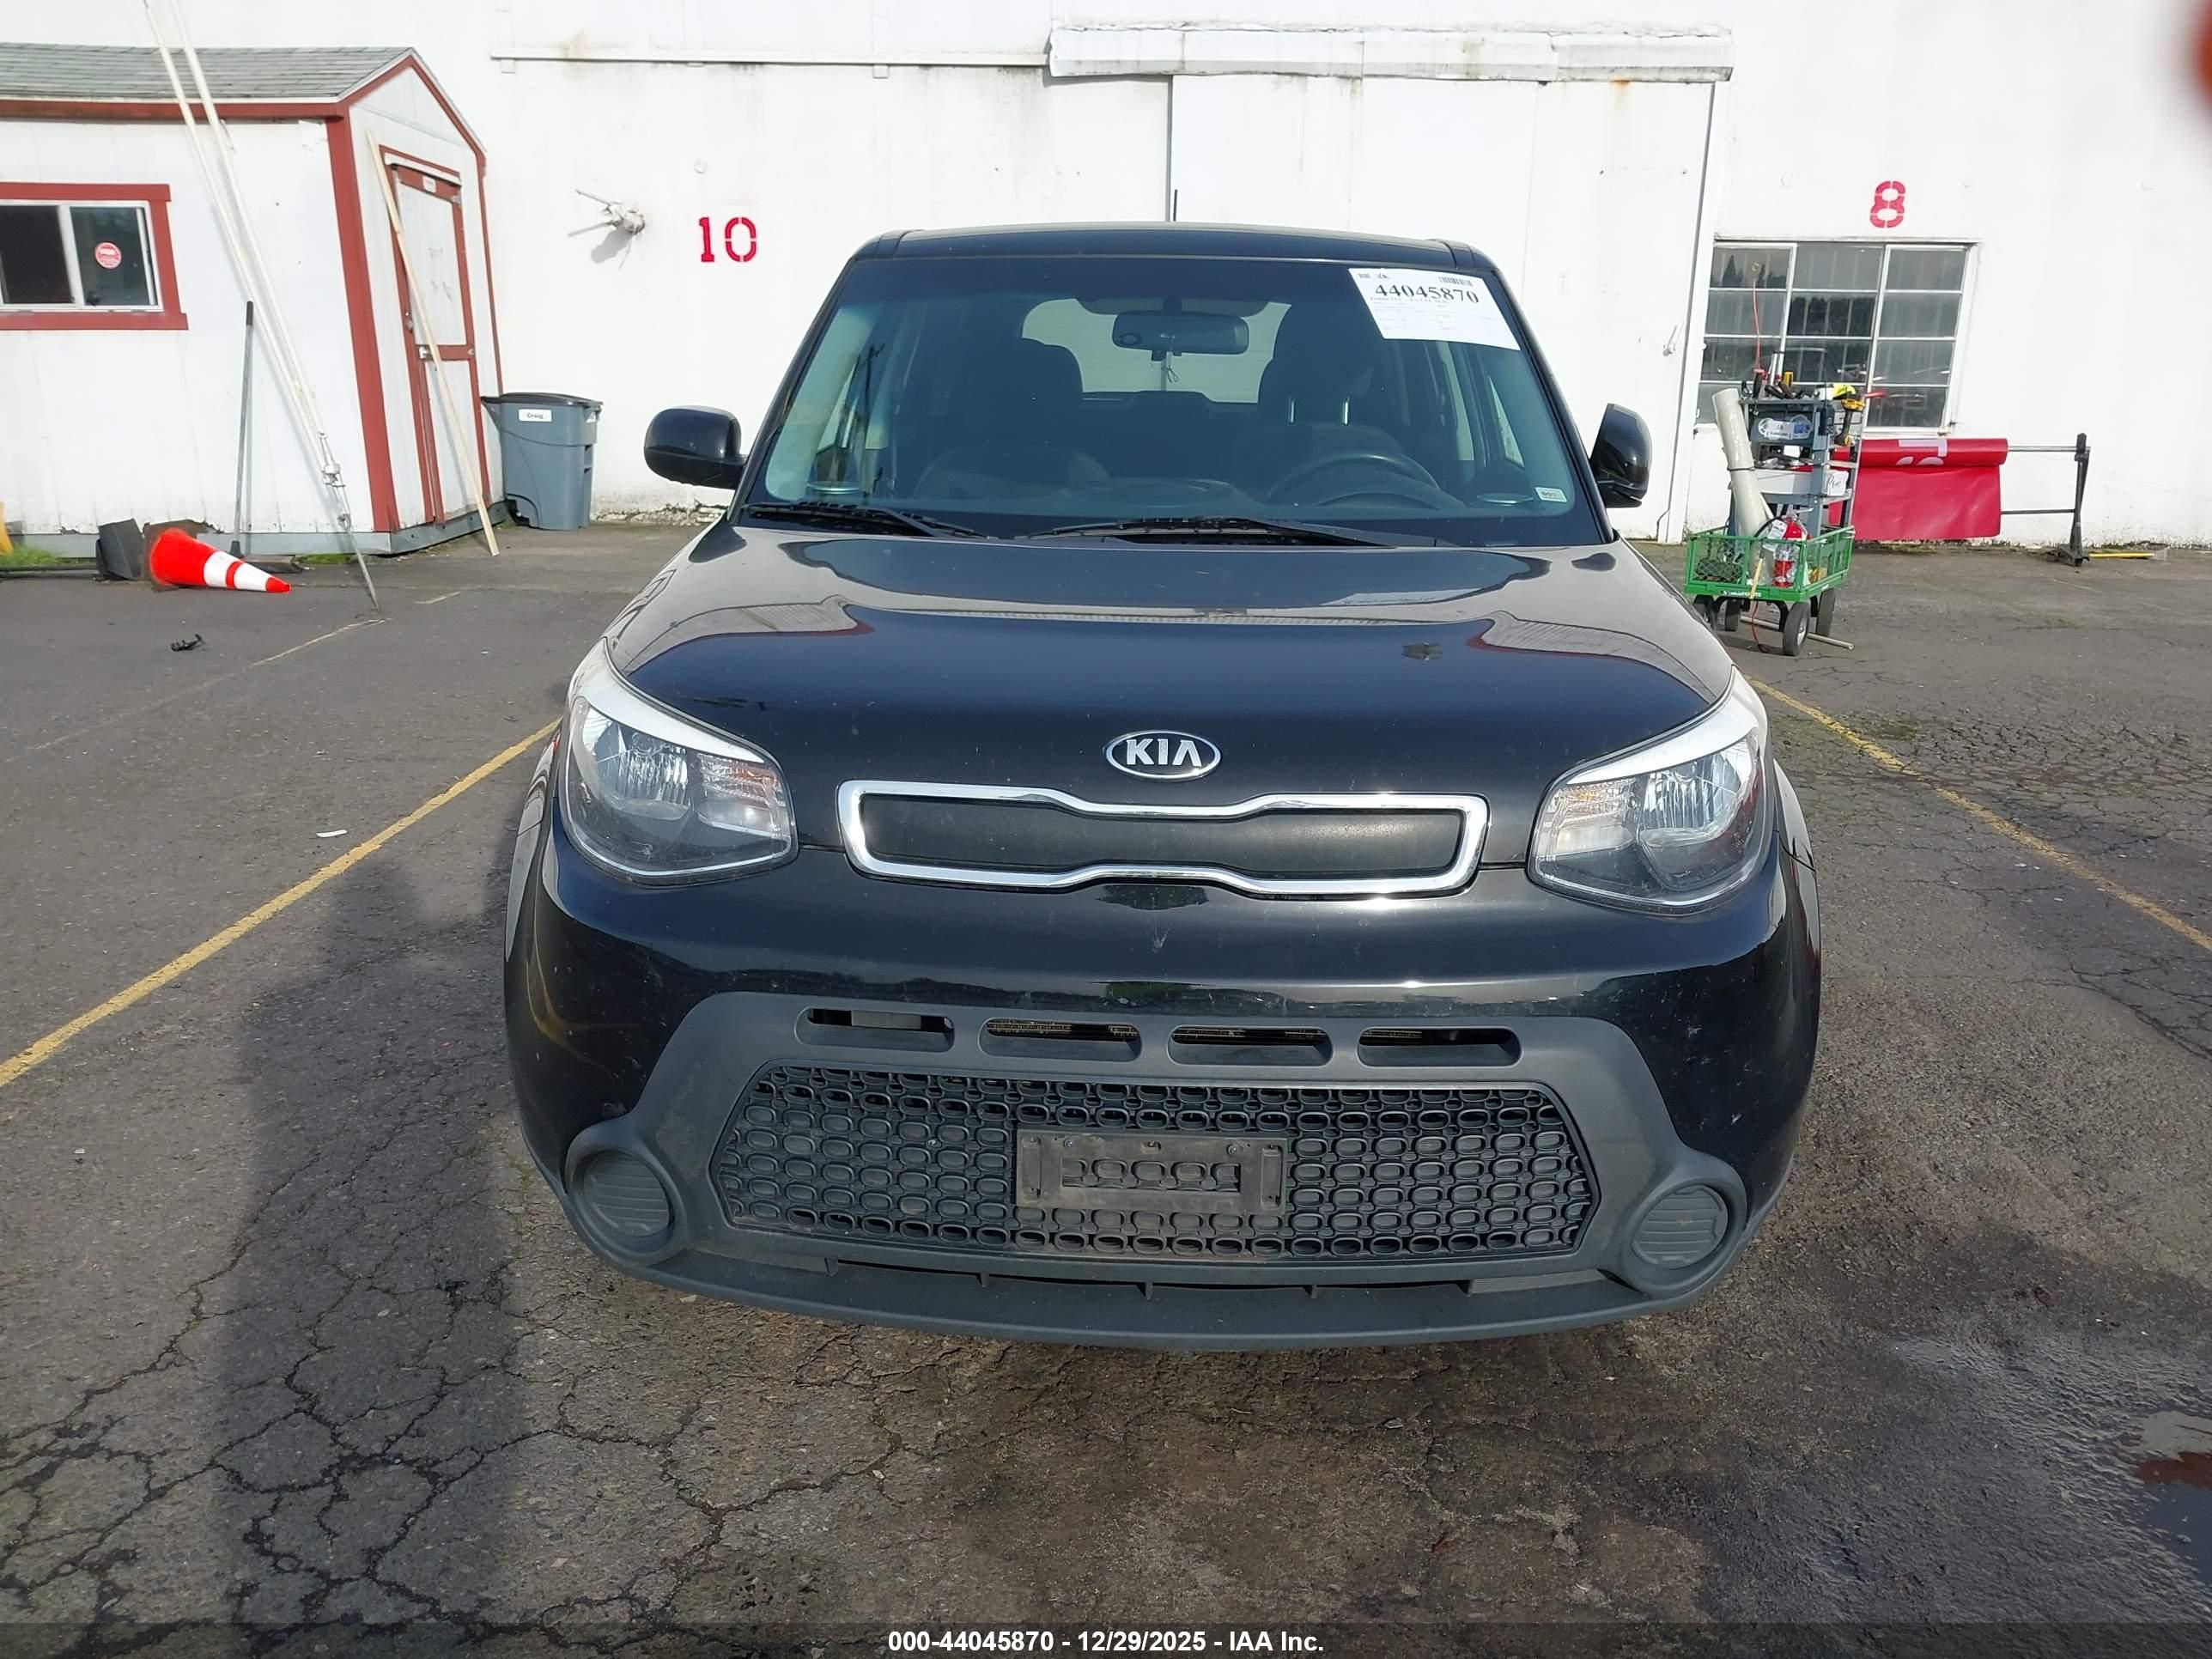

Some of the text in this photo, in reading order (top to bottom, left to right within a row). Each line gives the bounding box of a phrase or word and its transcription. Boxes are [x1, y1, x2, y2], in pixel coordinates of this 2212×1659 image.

[1869, 180, 1906, 228] 8
[698, 216, 757, 262] 10
[1375, 283, 1480, 304] 44045870
[1126, 738, 1202, 768] KIA
